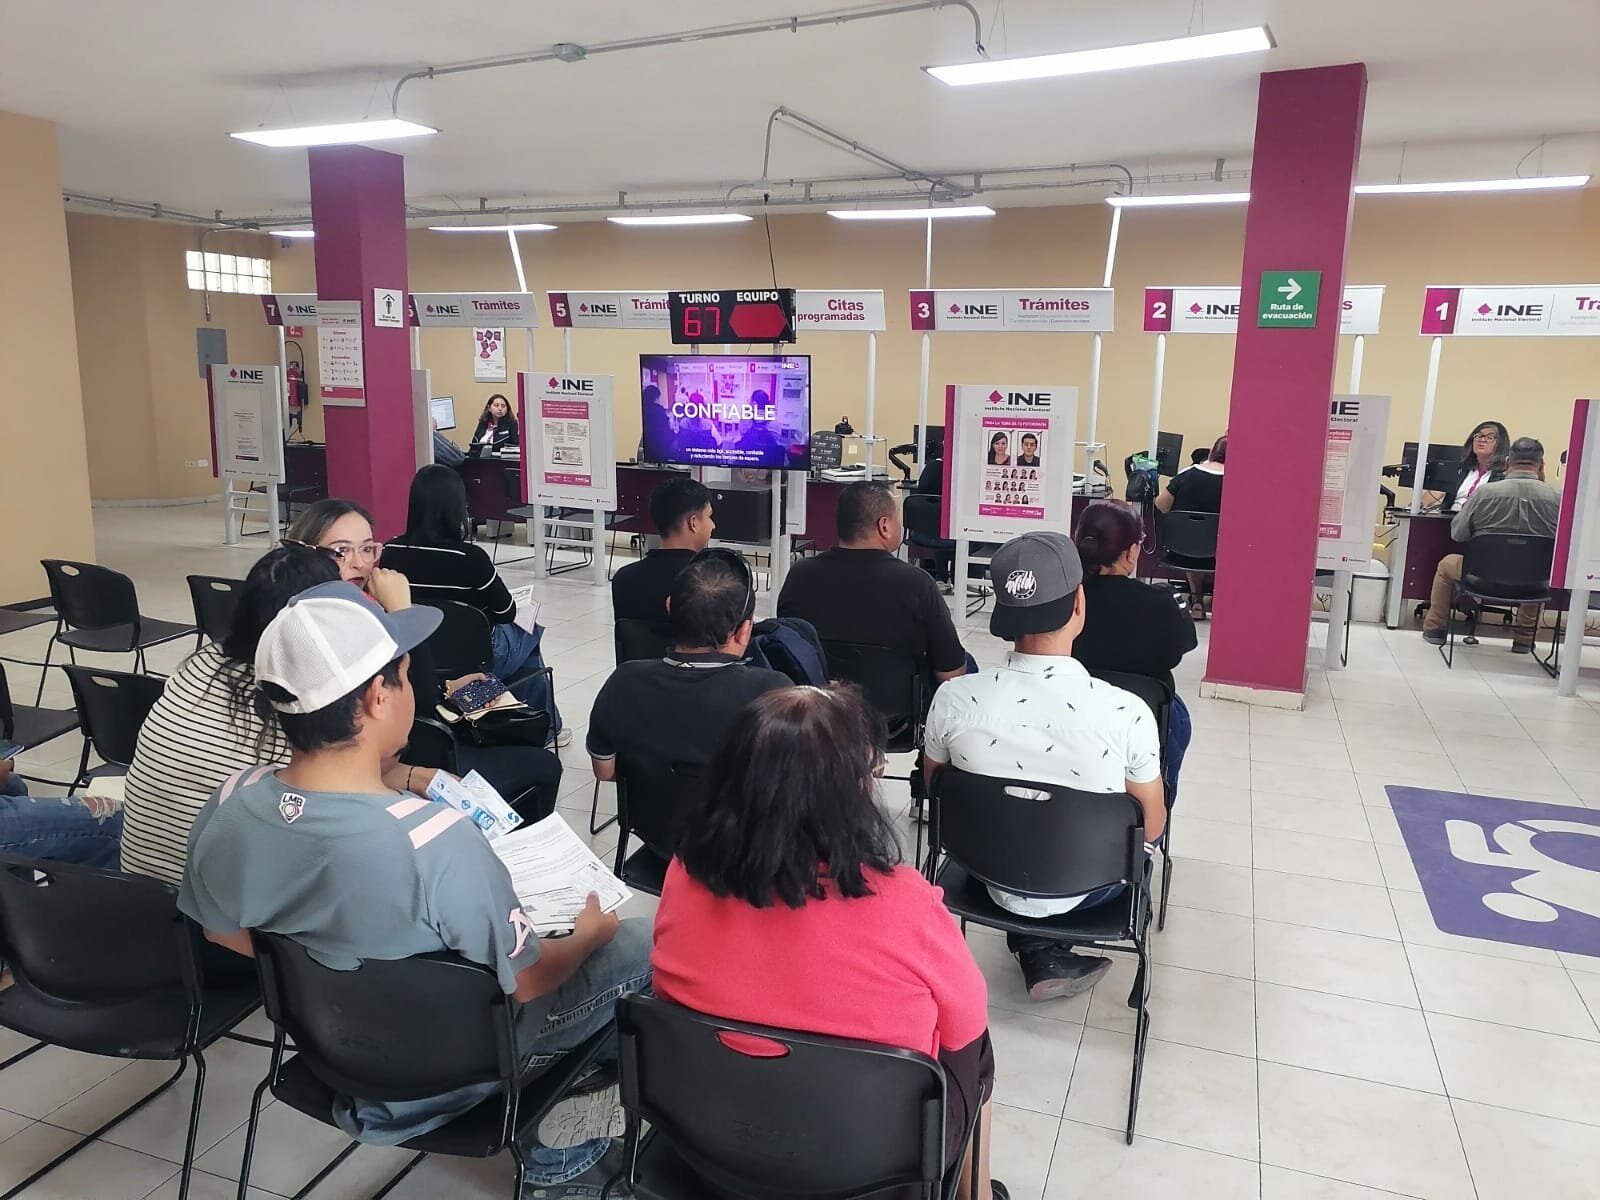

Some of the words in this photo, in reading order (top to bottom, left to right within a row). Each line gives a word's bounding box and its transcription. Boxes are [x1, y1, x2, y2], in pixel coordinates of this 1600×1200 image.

[679, 293, 721, 304] TURNO
[736, 291, 779, 302] EQUIPO
[295, 305, 317, 314] INE
[436, 305, 460, 314] INE
[472, 299, 521, 310] Trámites
[590, 304, 617, 313] INE
[827, 299, 864, 311] Citas
[964, 305, 998, 315] INE
[1019, 298, 1090, 310] Trámites
[1152, 301, 1167, 319] 2
[1206, 304, 1240, 315] INE
[1270, 303, 1292, 311] Ruta
[1292, 303, 1304, 311] de
[1497, 304, 1544, 316] INE
[267, 304, 276, 317] 7
[556, 303, 567, 318] 5
[917, 302, 931, 319] 3
[1262, 312, 1313, 320] evacuación
[1435, 302, 1449, 321] 1
[684, 306, 721, 337] 67
[797, 312, 865, 323] programadas
[240, 370, 264, 380] INE
[562, 379, 594, 391] INE
[1008, 392, 1051, 406] INE
[672, 402, 776, 421] CONFIABLE
[283, 794, 304, 807] LMB
